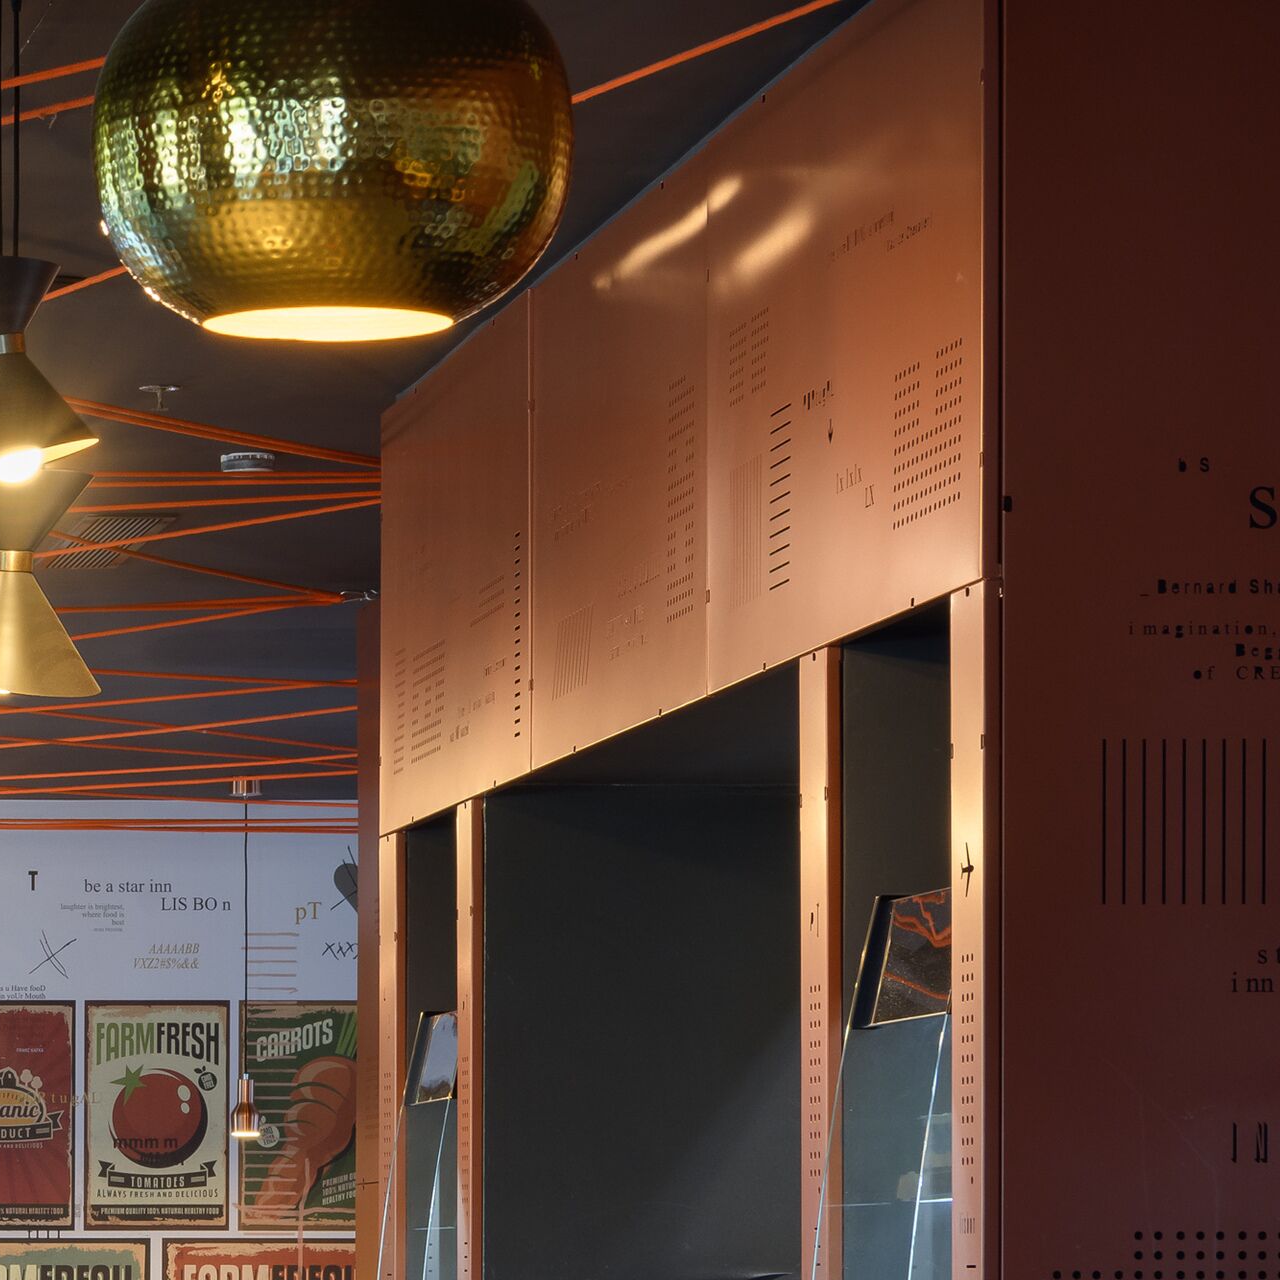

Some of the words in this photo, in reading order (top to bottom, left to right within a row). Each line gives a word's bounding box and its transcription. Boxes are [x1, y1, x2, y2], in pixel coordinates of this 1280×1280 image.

[84, 879, 101, 893] be
[106, 883, 113, 893] a
[118, 881, 144, 893] star
[150, 879, 172, 893] inn
[61, 903, 86, 911] laughter
[161, 897, 187, 911] LIS
[193, 897, 217, 911] BO
[222, 901, 231, 911] n
[82, 911, 101, 919] where
[256, 1018, 333, 1062] CARROTS
[130, 1175, 185, 1188] TOMATOES
[322, 1173, 349, 1188] PREMIUM
[97, 1188, 127, 1198] ALWAYS
[129, 1190, 155, 1198] FRESH
[156, 1190, 173, 1198] AND
[175, 1188, 218, 1198] DELICIOUS
[322, 1193, 346, 1206] HEALTHY
[5, 1207, 28, 1215] NATURAL
[50, 1207, 64, 1215] FOOD
[100, 1207, 125, 1215] PREMIUM
[125, 1207, 146, 1215] QUALITY
[146, 1207, 160, 1215] 100%
[161, 1207, 183, 1215] NATURAL
[184, 1207, 205, 1215] HEALTHY
[205, 1207, 220, 1215] FOOD
